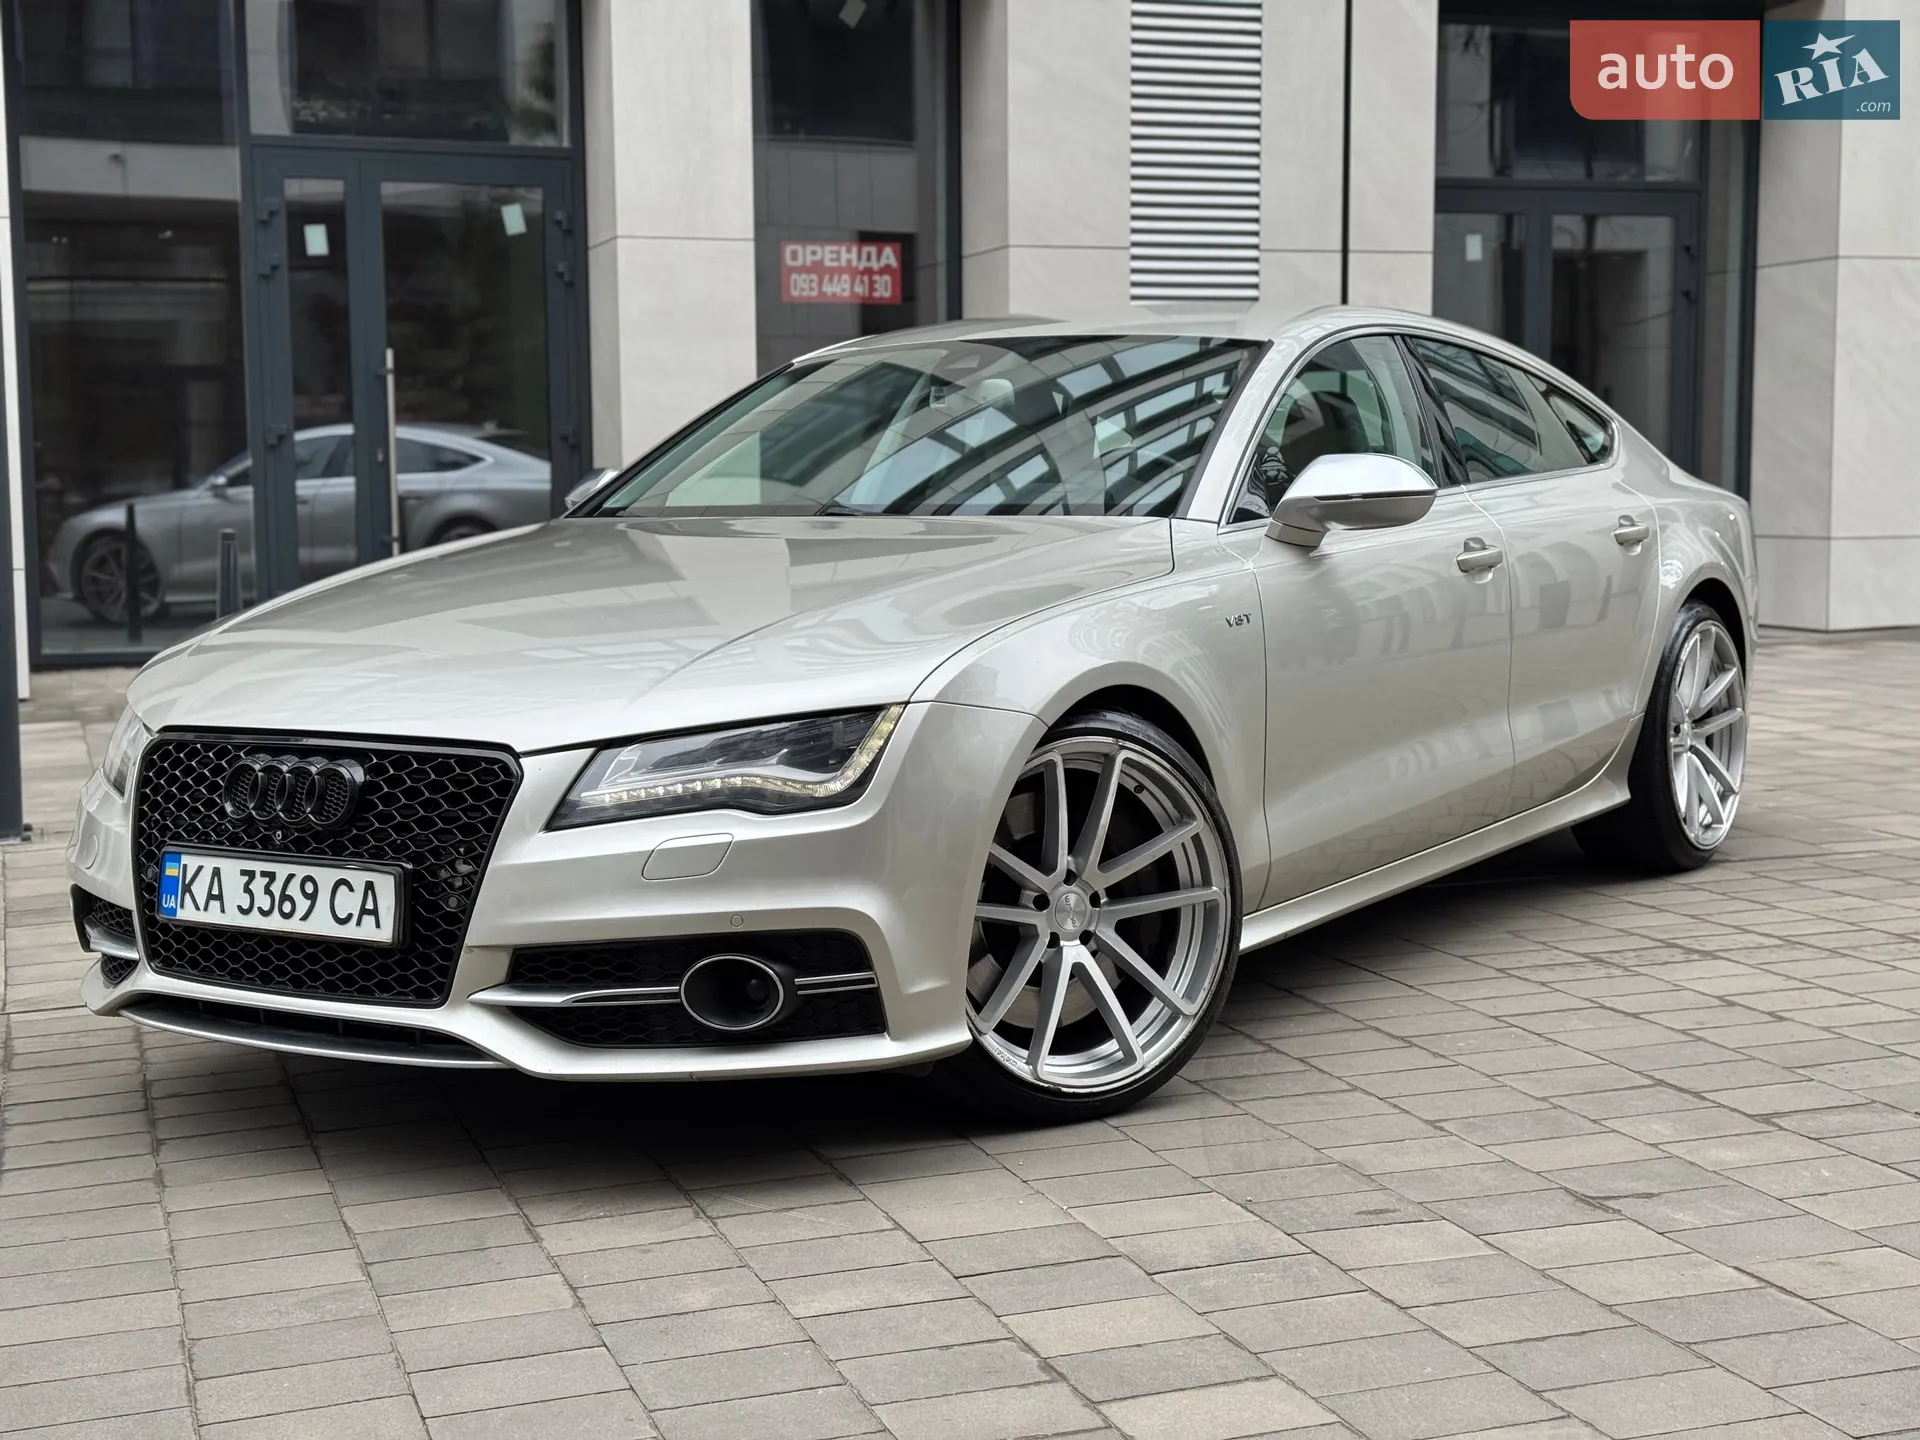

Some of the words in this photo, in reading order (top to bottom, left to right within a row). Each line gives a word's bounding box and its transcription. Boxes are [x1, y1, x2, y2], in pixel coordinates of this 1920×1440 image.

[785, 244, 898, 269] ОРЕНДА
[790, 273, 819, 297] 093
[822, 273, 851, 297] 449
[854, 274, 869, 297] 41
[872, 274, 892, 298] 30
[162, 893, 177, 909] UA
[180, 863, 226, 913] KA
[236, 868, 319, 921] 3369
[329, 877, 381, 929] CA
